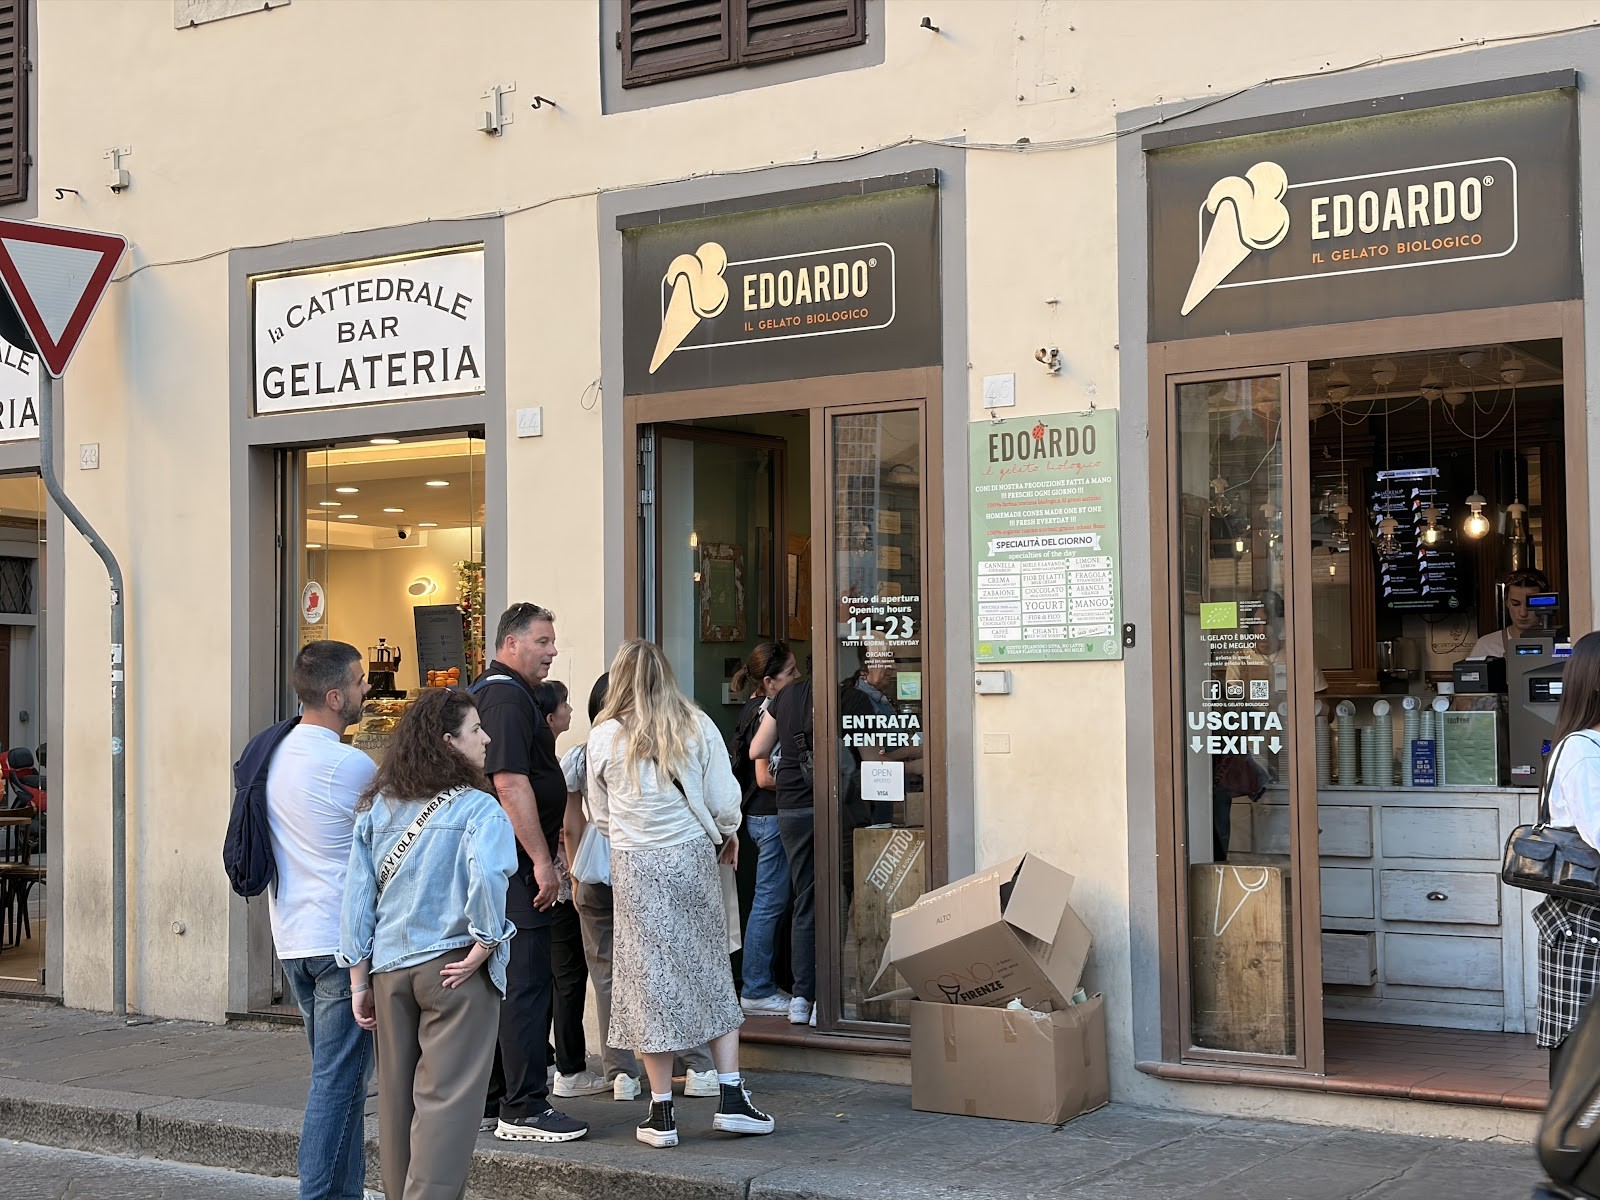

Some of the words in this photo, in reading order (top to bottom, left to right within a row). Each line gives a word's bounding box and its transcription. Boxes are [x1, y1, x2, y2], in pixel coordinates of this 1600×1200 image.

[1312, 251, 1325, 264] IL
[1331, 244, 1389, 262] GELATO
[1397, 233, 1482, 255] BIOLOGICO
[267, 326, 285, 344] la
[286, 278, 473, 329] CATTEDRALE
[744, 322, 754, 332] IL
[758, 316, 801, 330] GELATO
[807, 308, 869, 325] BIOLOGICO
[338, 316, 399, 344] BAR
[0, 341, 34, 376] LE
[263, 345, 480, 399] GELATERIA
[985, 379, 1012, 404] 45
[0, 397, 39, 429] IA
[519, 412, 540, 433] 44
[989, 424, 1096, 463] EDOARDO
[81, 449, 97, 466] 43
[999, 483, 1024, 491] NOSTRA
[1024, 480, 1065, 489] PRODUZIONE
[1066, 478, 1085, 486] FATTI
[1091, 476, 1112, 484] MANO
[1008, 491, 1034, 499] FRESCHI
[1051, 488, 1077, 496] GIORNO
[986, 510, 1022, 519] HOMEMADE
[1022, 508, 1043, 517] CONES
[1037, 517, 1070, 525] EVERYDAY
[996, 536, 1040, 549] SPECIALITÀ
[1041, 538, 1057, 547] DEL
[1058, 536, 1092, 545] GIORNO
[1008, 551, 1041, 560] specialties
[1064, 550, 1077, 558] day
[841, 596, 868, 604] Orario
[871, 595, 879, 603] di
[881, 595, 919, 604] apertura
[1025, 601, 1065, 610] YOGURT
[1075, 599, 1109, 608] MANGO
[849, 606, 884, 615] Opening
[847, 616, 914, 640] 11-23
[843, 714, 920, 729] ENTRATA
[1188, 711, 1282, 731] USCITA
[853, 732, 910, 747] ENTER
[1206, 736, 1265, 755] EXIT
[872, 769, 892, 777] OPEN
[393, 831, 416, 859] LOLA
[871, 829, 914, 890] EDOARDO
[936, 913, 952, 925] ALTO
[960, 980, 1005, 1002] FIRENZE
